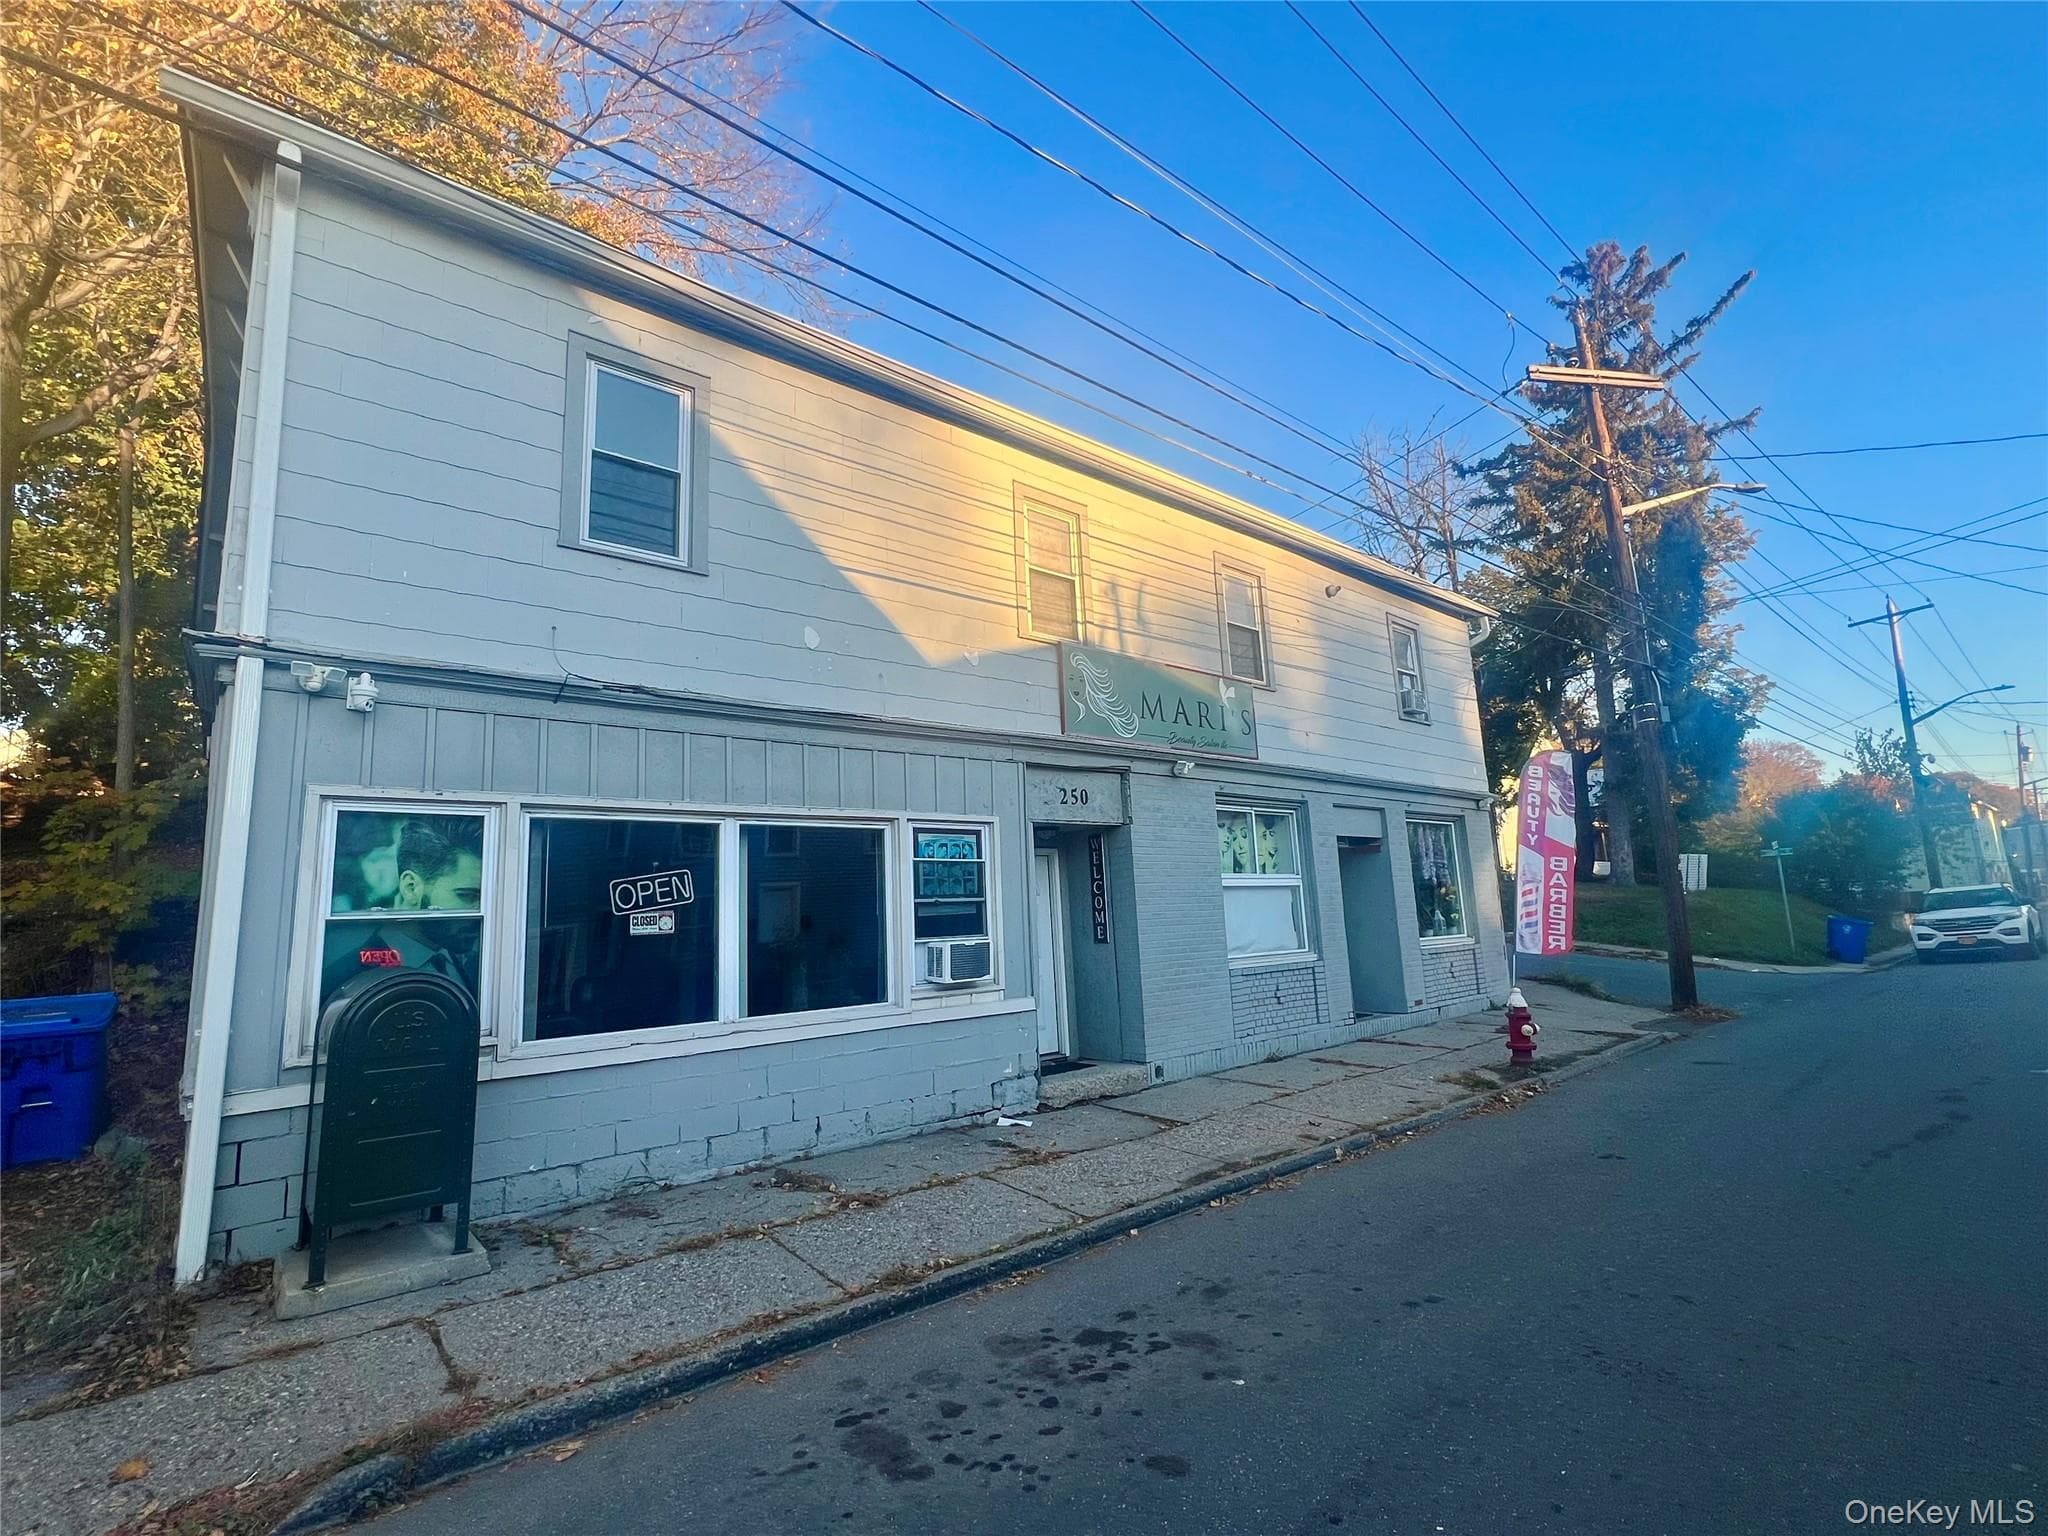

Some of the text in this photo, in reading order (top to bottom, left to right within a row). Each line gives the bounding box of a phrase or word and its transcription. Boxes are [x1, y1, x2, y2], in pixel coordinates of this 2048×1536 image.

[1140, 690, 1252, 736] MARI'S
[1059, 787, 1089, 806] 250
[615, 875, 690, 909] OPEN
[1090, 836, 1105, 939] WELCOME
[631, 914, 658, 927] CLOSED
